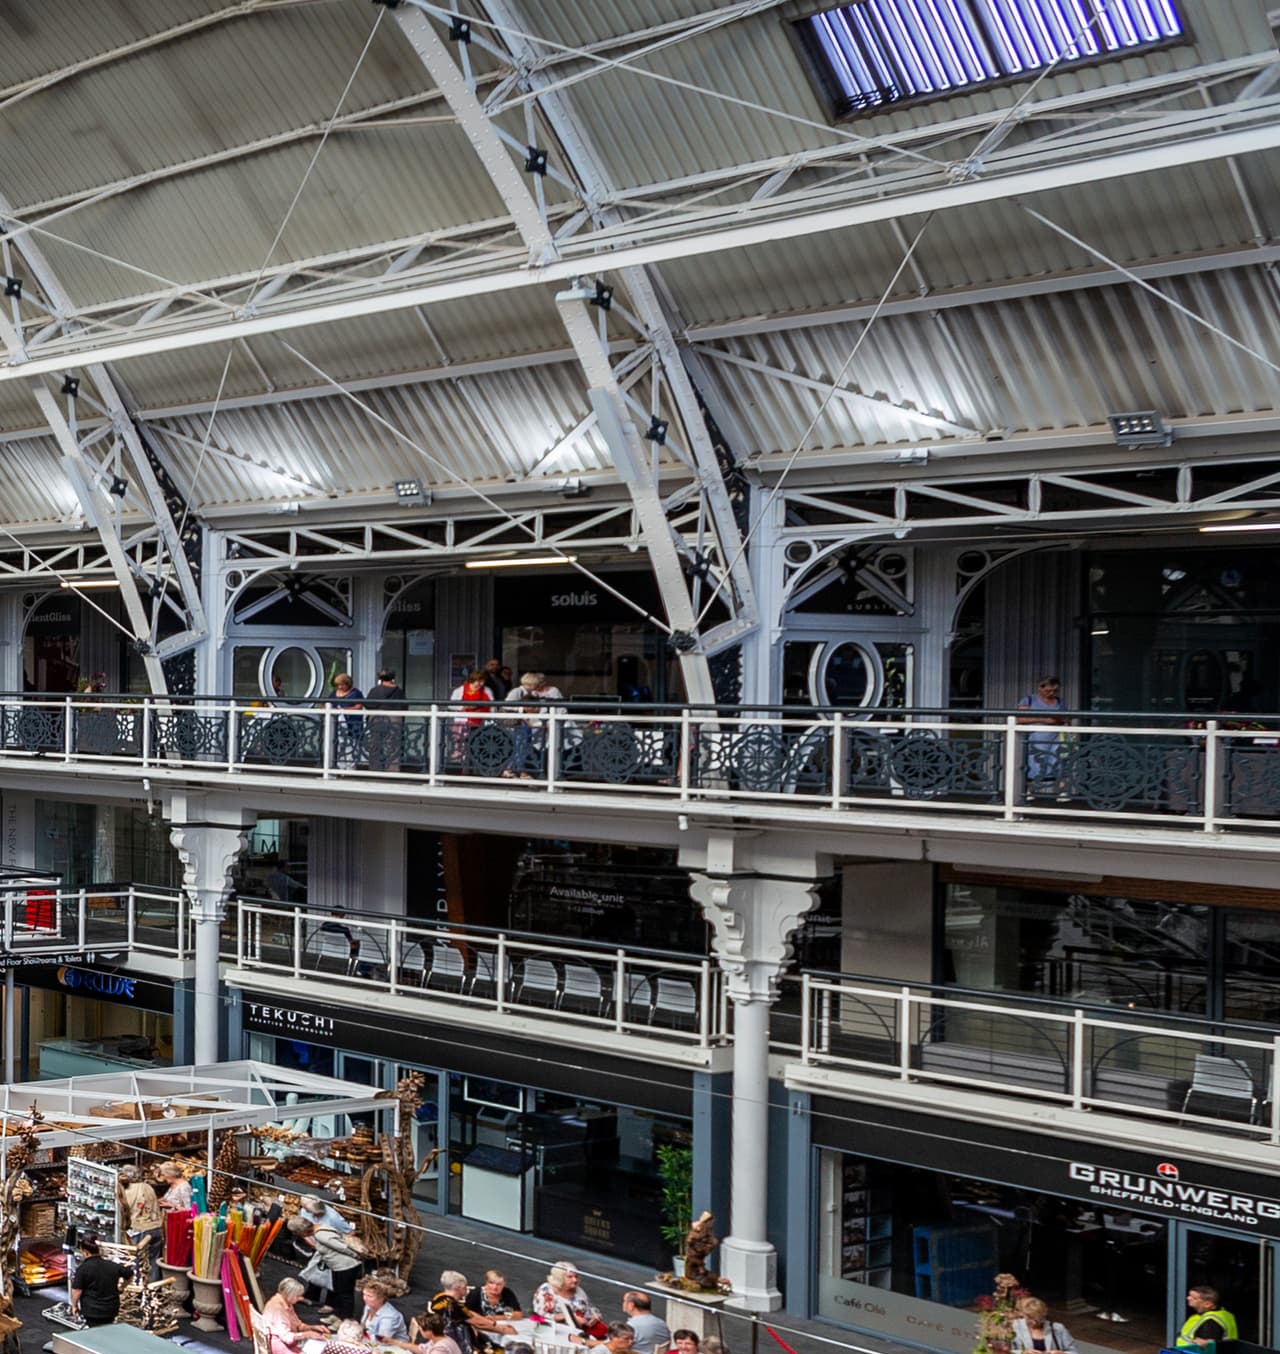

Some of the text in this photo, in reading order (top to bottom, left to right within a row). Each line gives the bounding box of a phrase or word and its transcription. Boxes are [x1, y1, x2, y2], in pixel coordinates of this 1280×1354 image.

[549, 886, 598, 901] Available
[250, 1004, 334, 1029] TEKUCHI
[1069, 1161, 1280, 1220] GRUNWERG
